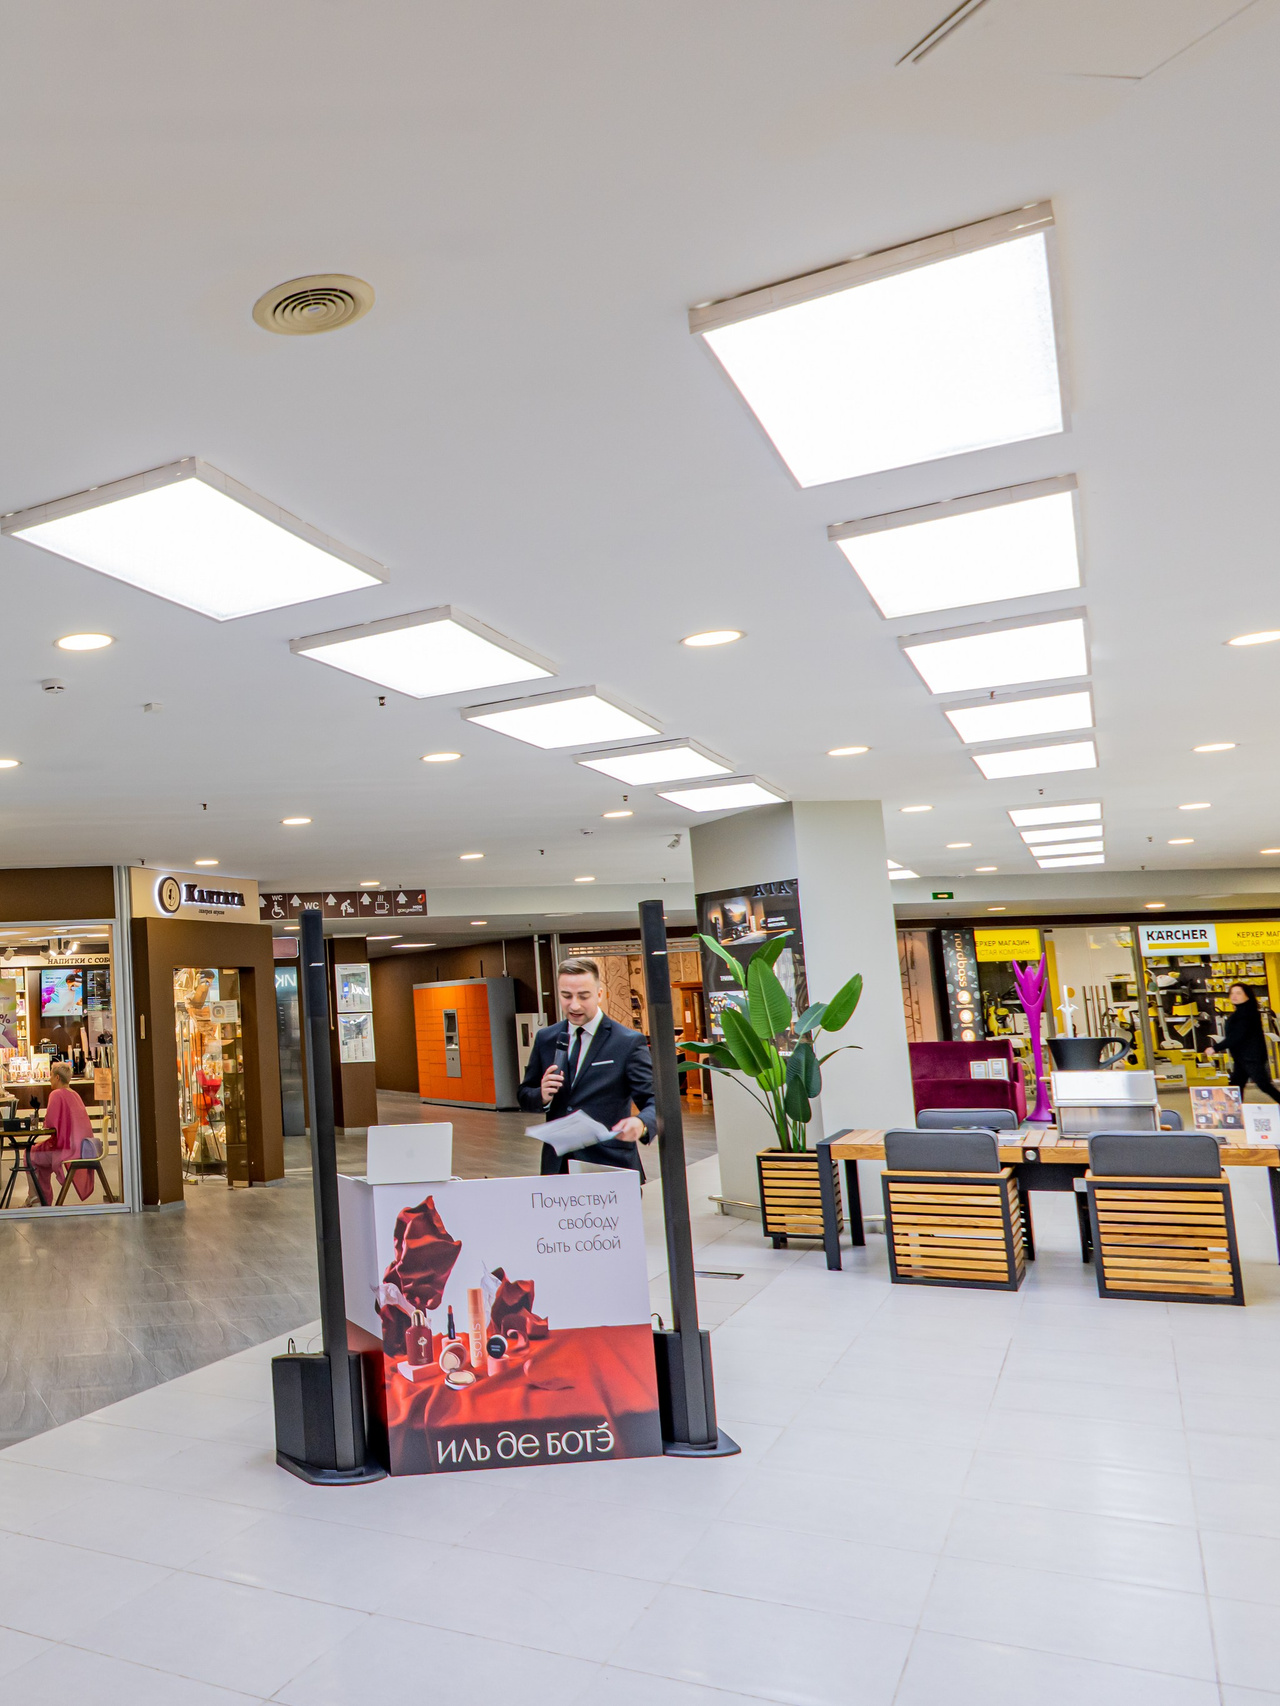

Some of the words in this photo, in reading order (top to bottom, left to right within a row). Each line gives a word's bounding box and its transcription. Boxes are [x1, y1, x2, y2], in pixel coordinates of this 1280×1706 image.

[303, 902, 320, 910] WC
[974, 940, 997, 948] ЕРХЕР
[1236, 931, 1264, 939] КЕРХЕР
[48, 957, 86, 965] НАПИТКИ
[954, 932, 968, 988] nordbass
[531, 1190, 618, 1211] Почувствуй
[558, 1212, 619, 1231] свободу
[536, 1237, 571, 1254] быть
[575, 1234, 621, 1252] собой
[473, 1322, 483, 1359] SOLIS
